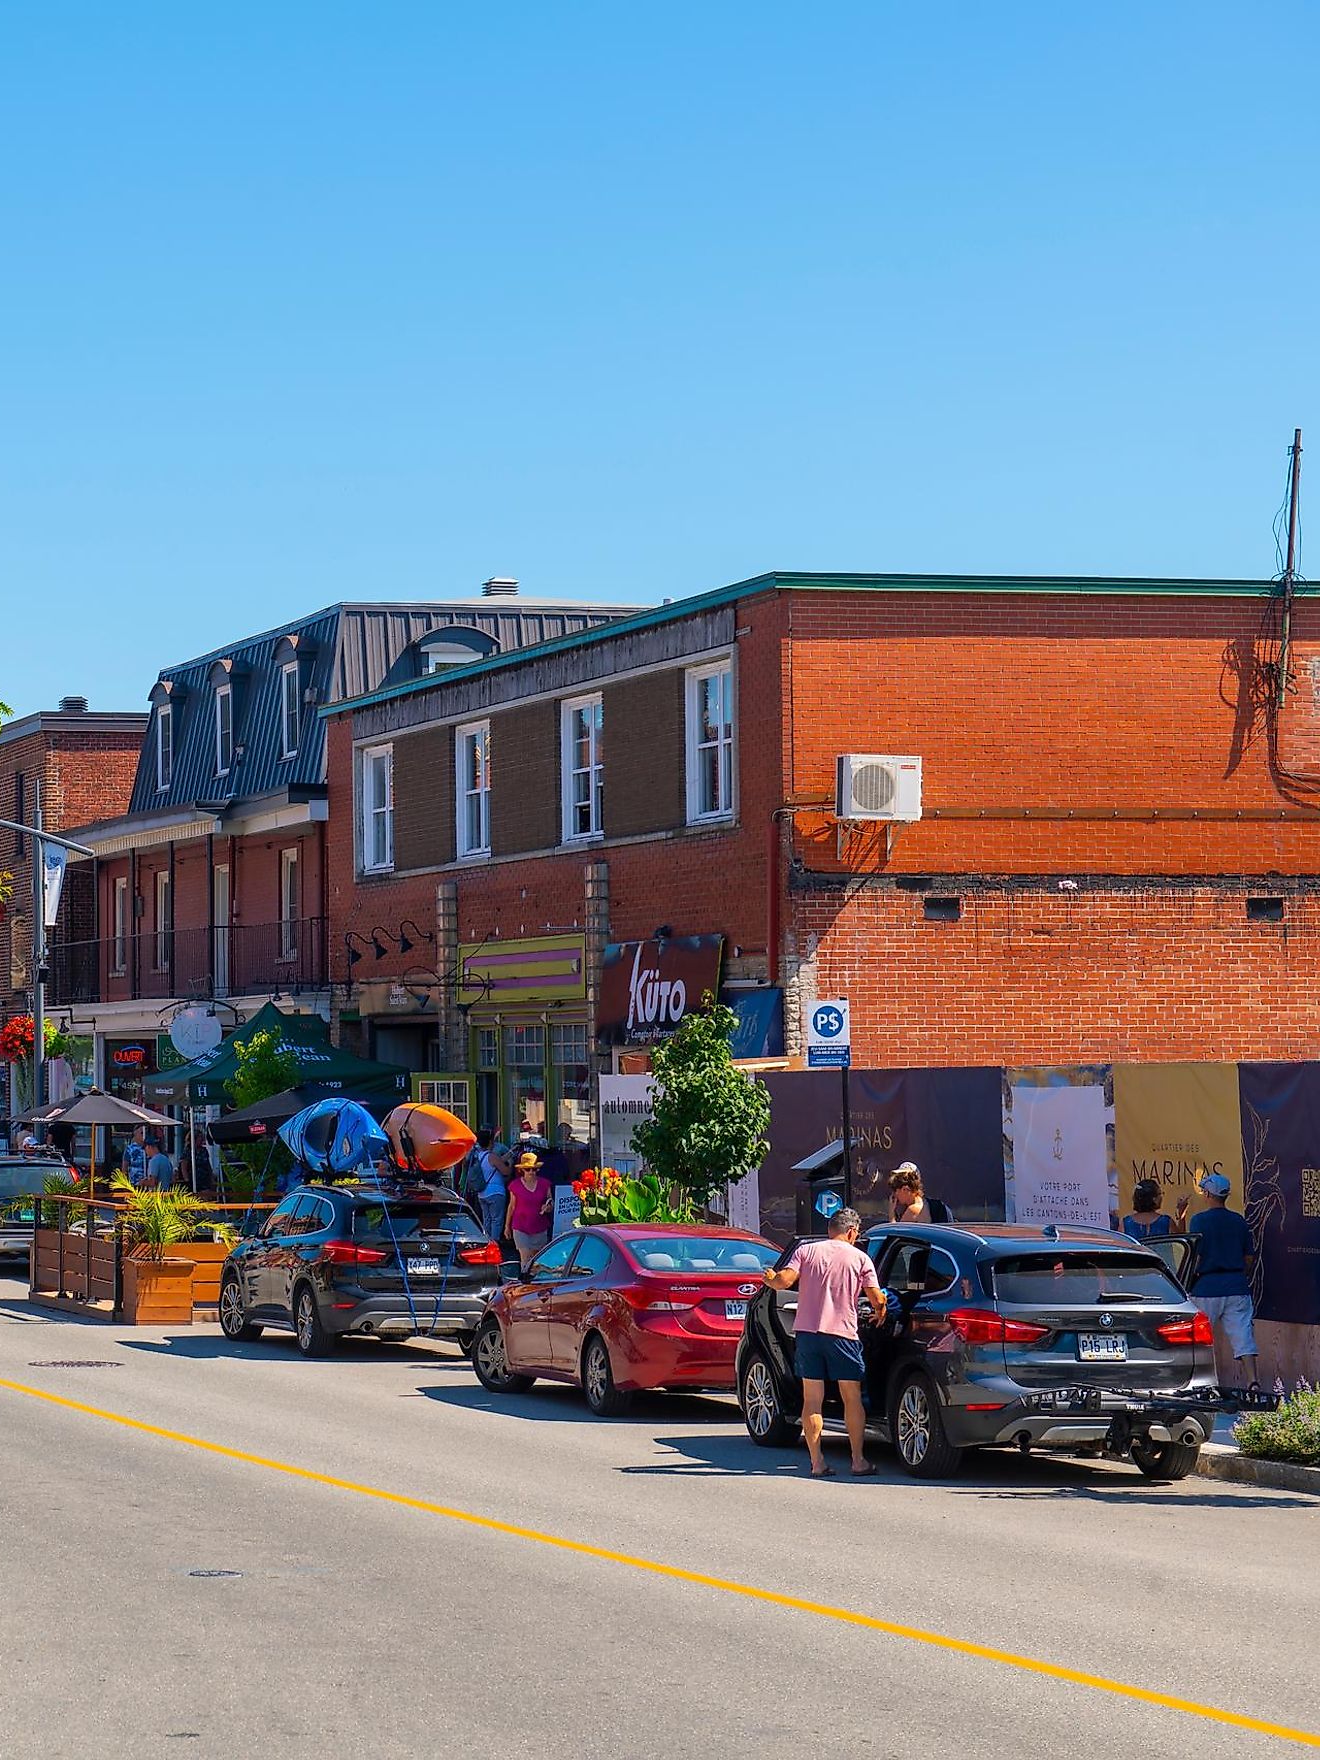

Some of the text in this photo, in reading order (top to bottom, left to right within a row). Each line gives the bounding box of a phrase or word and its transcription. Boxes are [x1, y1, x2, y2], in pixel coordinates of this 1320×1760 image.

[626, 942, 686, 1029] KÜTO
[273, 1043, 316, 1054] ubert
[114, 1050, 143, 1063] OUVERT
[198, 1086, 208, 1097] H
[604, 1096, 651, 1114] automne
[826, 1125, 892, 1149] MINAS
[1132, 1159, 1224, 1186] MARINAS
[1040, 1182, 1082, 1191] VOTRE PORT
[822, 1194, 838, 1212] P
[1033, 1194, 1089, 1206] D'ATTACHE DANS
[1023, 1207, 1102, 1221] LES CANTONS-DE-L'EST
[1082, 1340, 1125, 1354] P15 LRJ
[1126, 1403, 1145, 1411] THULE
